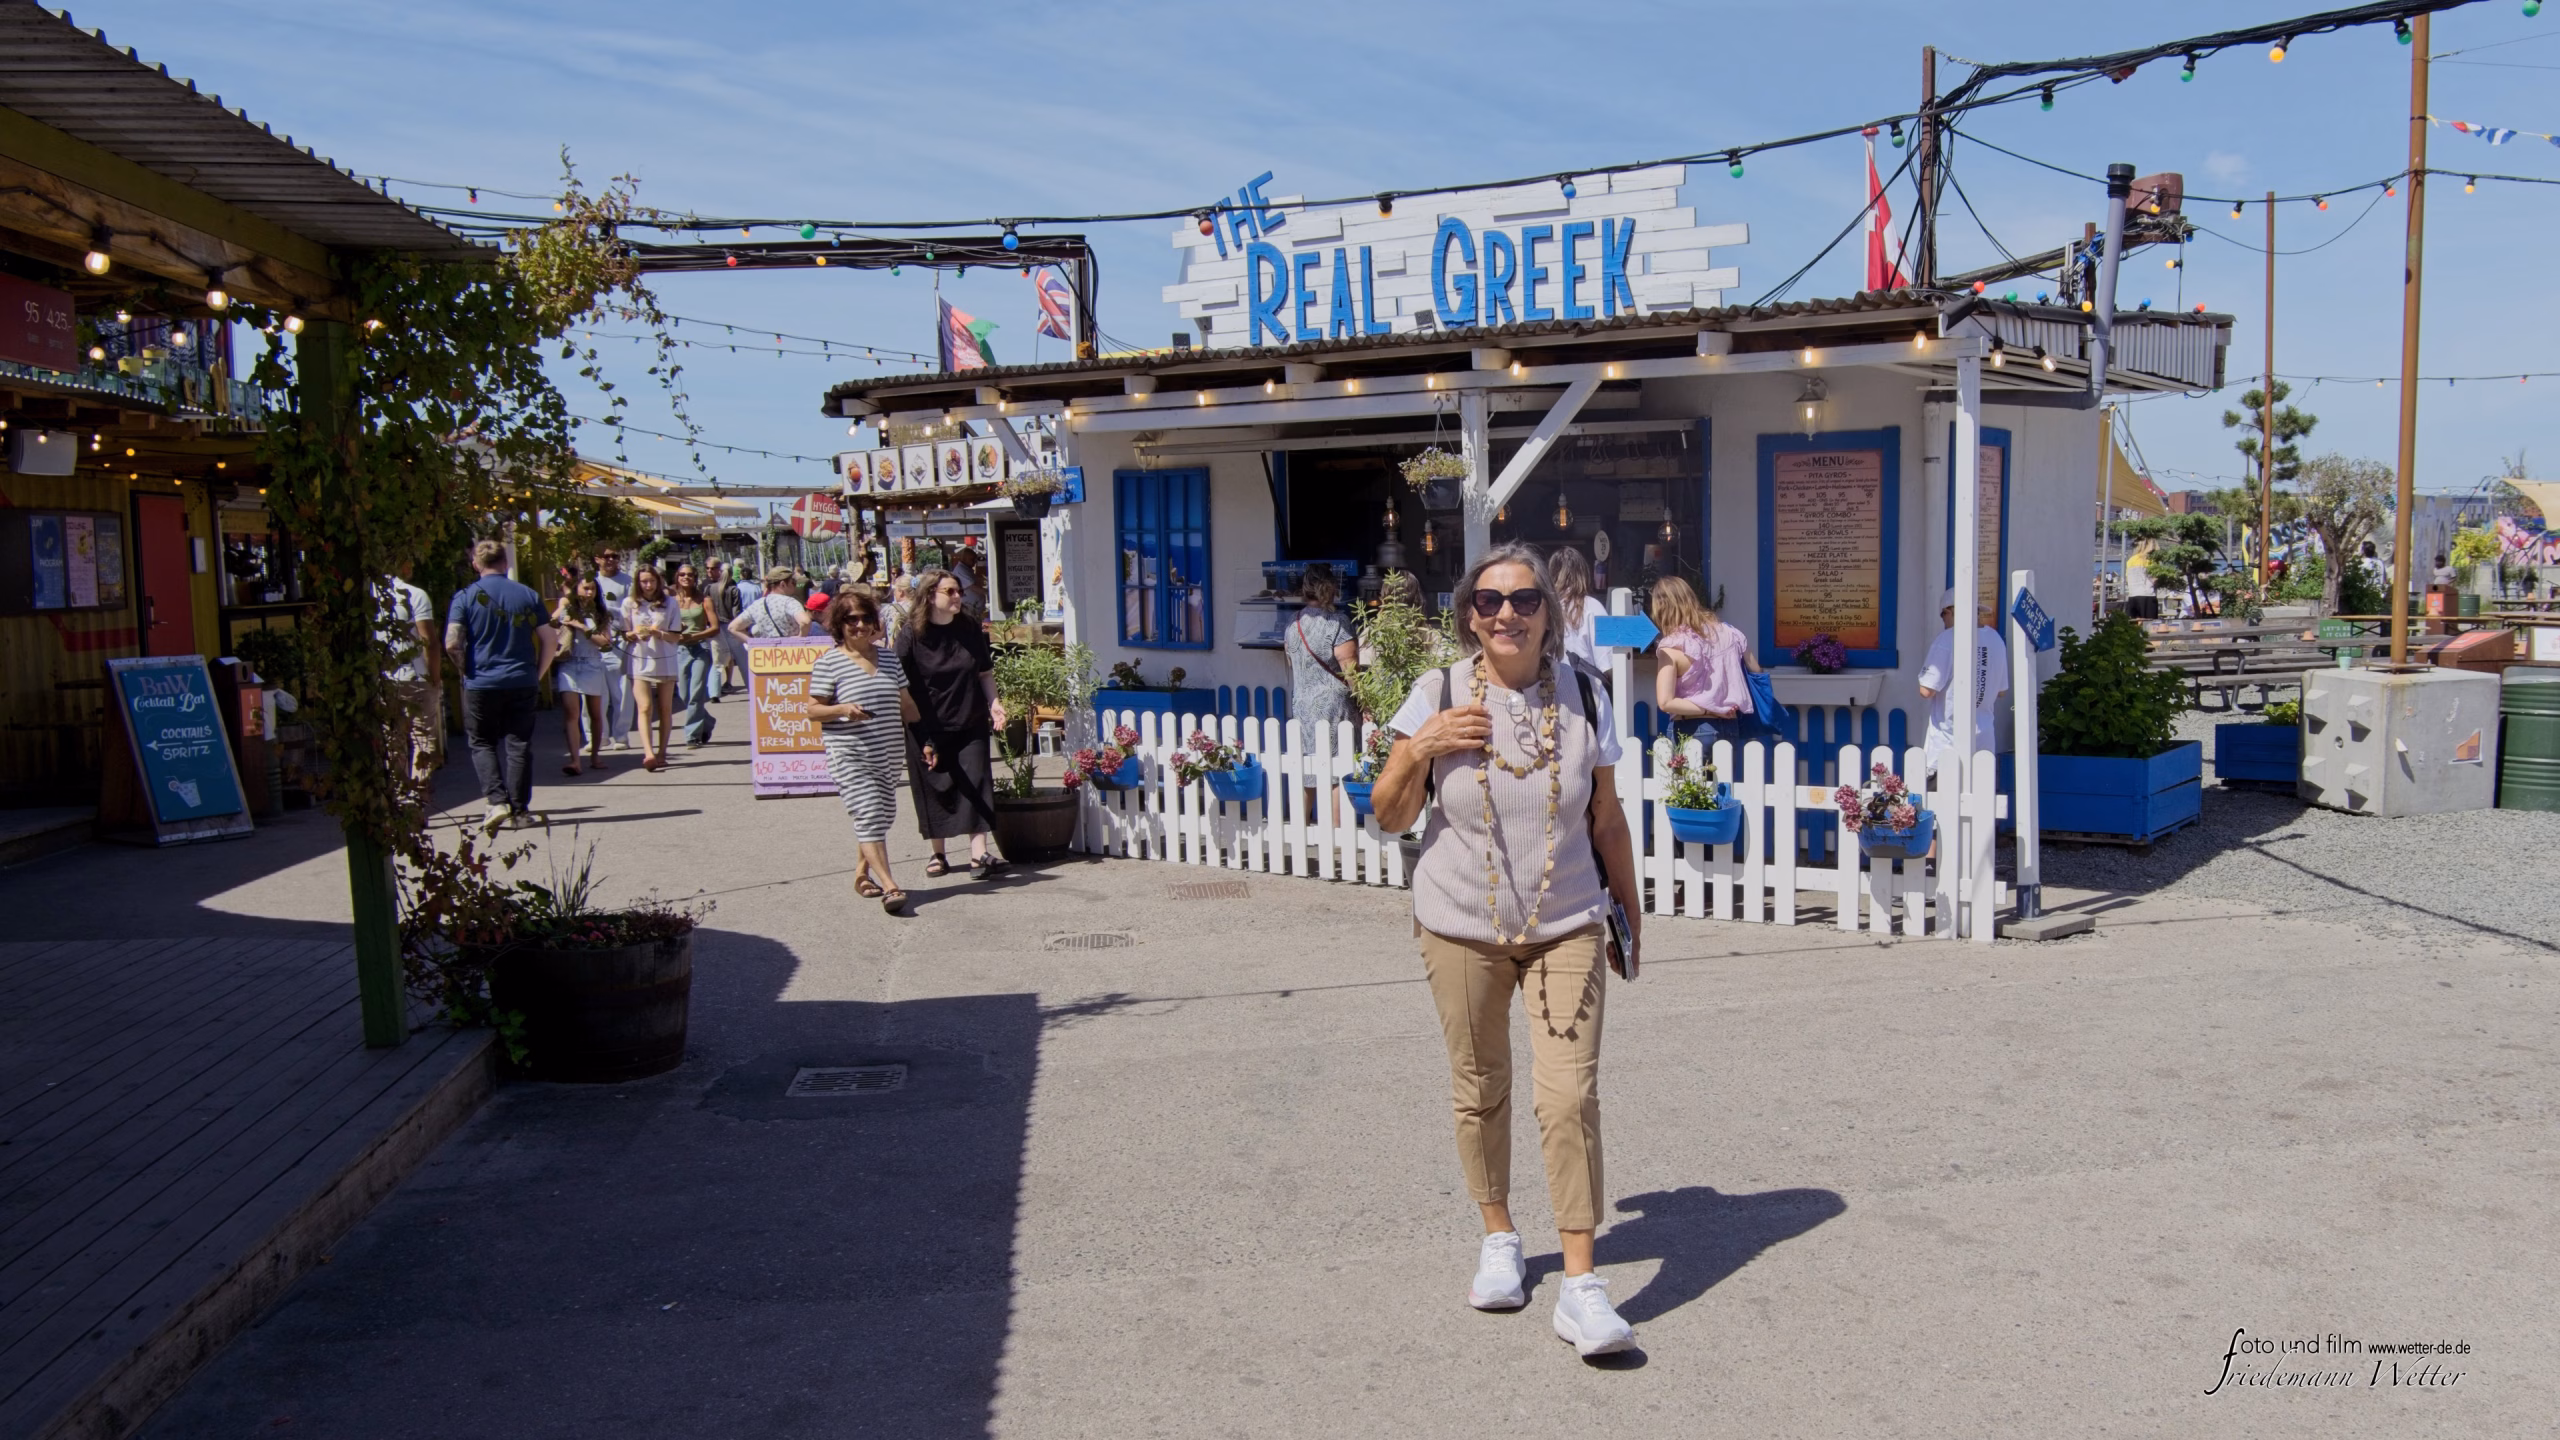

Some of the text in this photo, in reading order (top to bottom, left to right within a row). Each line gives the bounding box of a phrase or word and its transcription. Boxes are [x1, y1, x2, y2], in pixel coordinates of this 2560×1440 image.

[1210, 171, 1287, 258] THE
[1246, 217, 1637, 346] REAL GREEK
[1812, 456, 1845, 467] MENU
[813, 501, 837, 514] HYGGE
[1006, 533, 1034, 543] HYGGE
[2020, 599, 2042, 631] STARTS
[2025, 592, 2048, 628] THE LINE
[2026, 622, 2041, 643] HERE
[138, 674, 193, 697] BnW
[766, 677, 807, 697] Meat
[133, 692, 206, 713] Cocktail Bar
[756, 696, 809, 718] Vegetaria
[161, 725, 213, 741] COCKTAILS
[768, 715, 812, 737] Vegan
[760, 736, 795, 748] FRESH
[162, 746, 211, 762] SPRITZ
